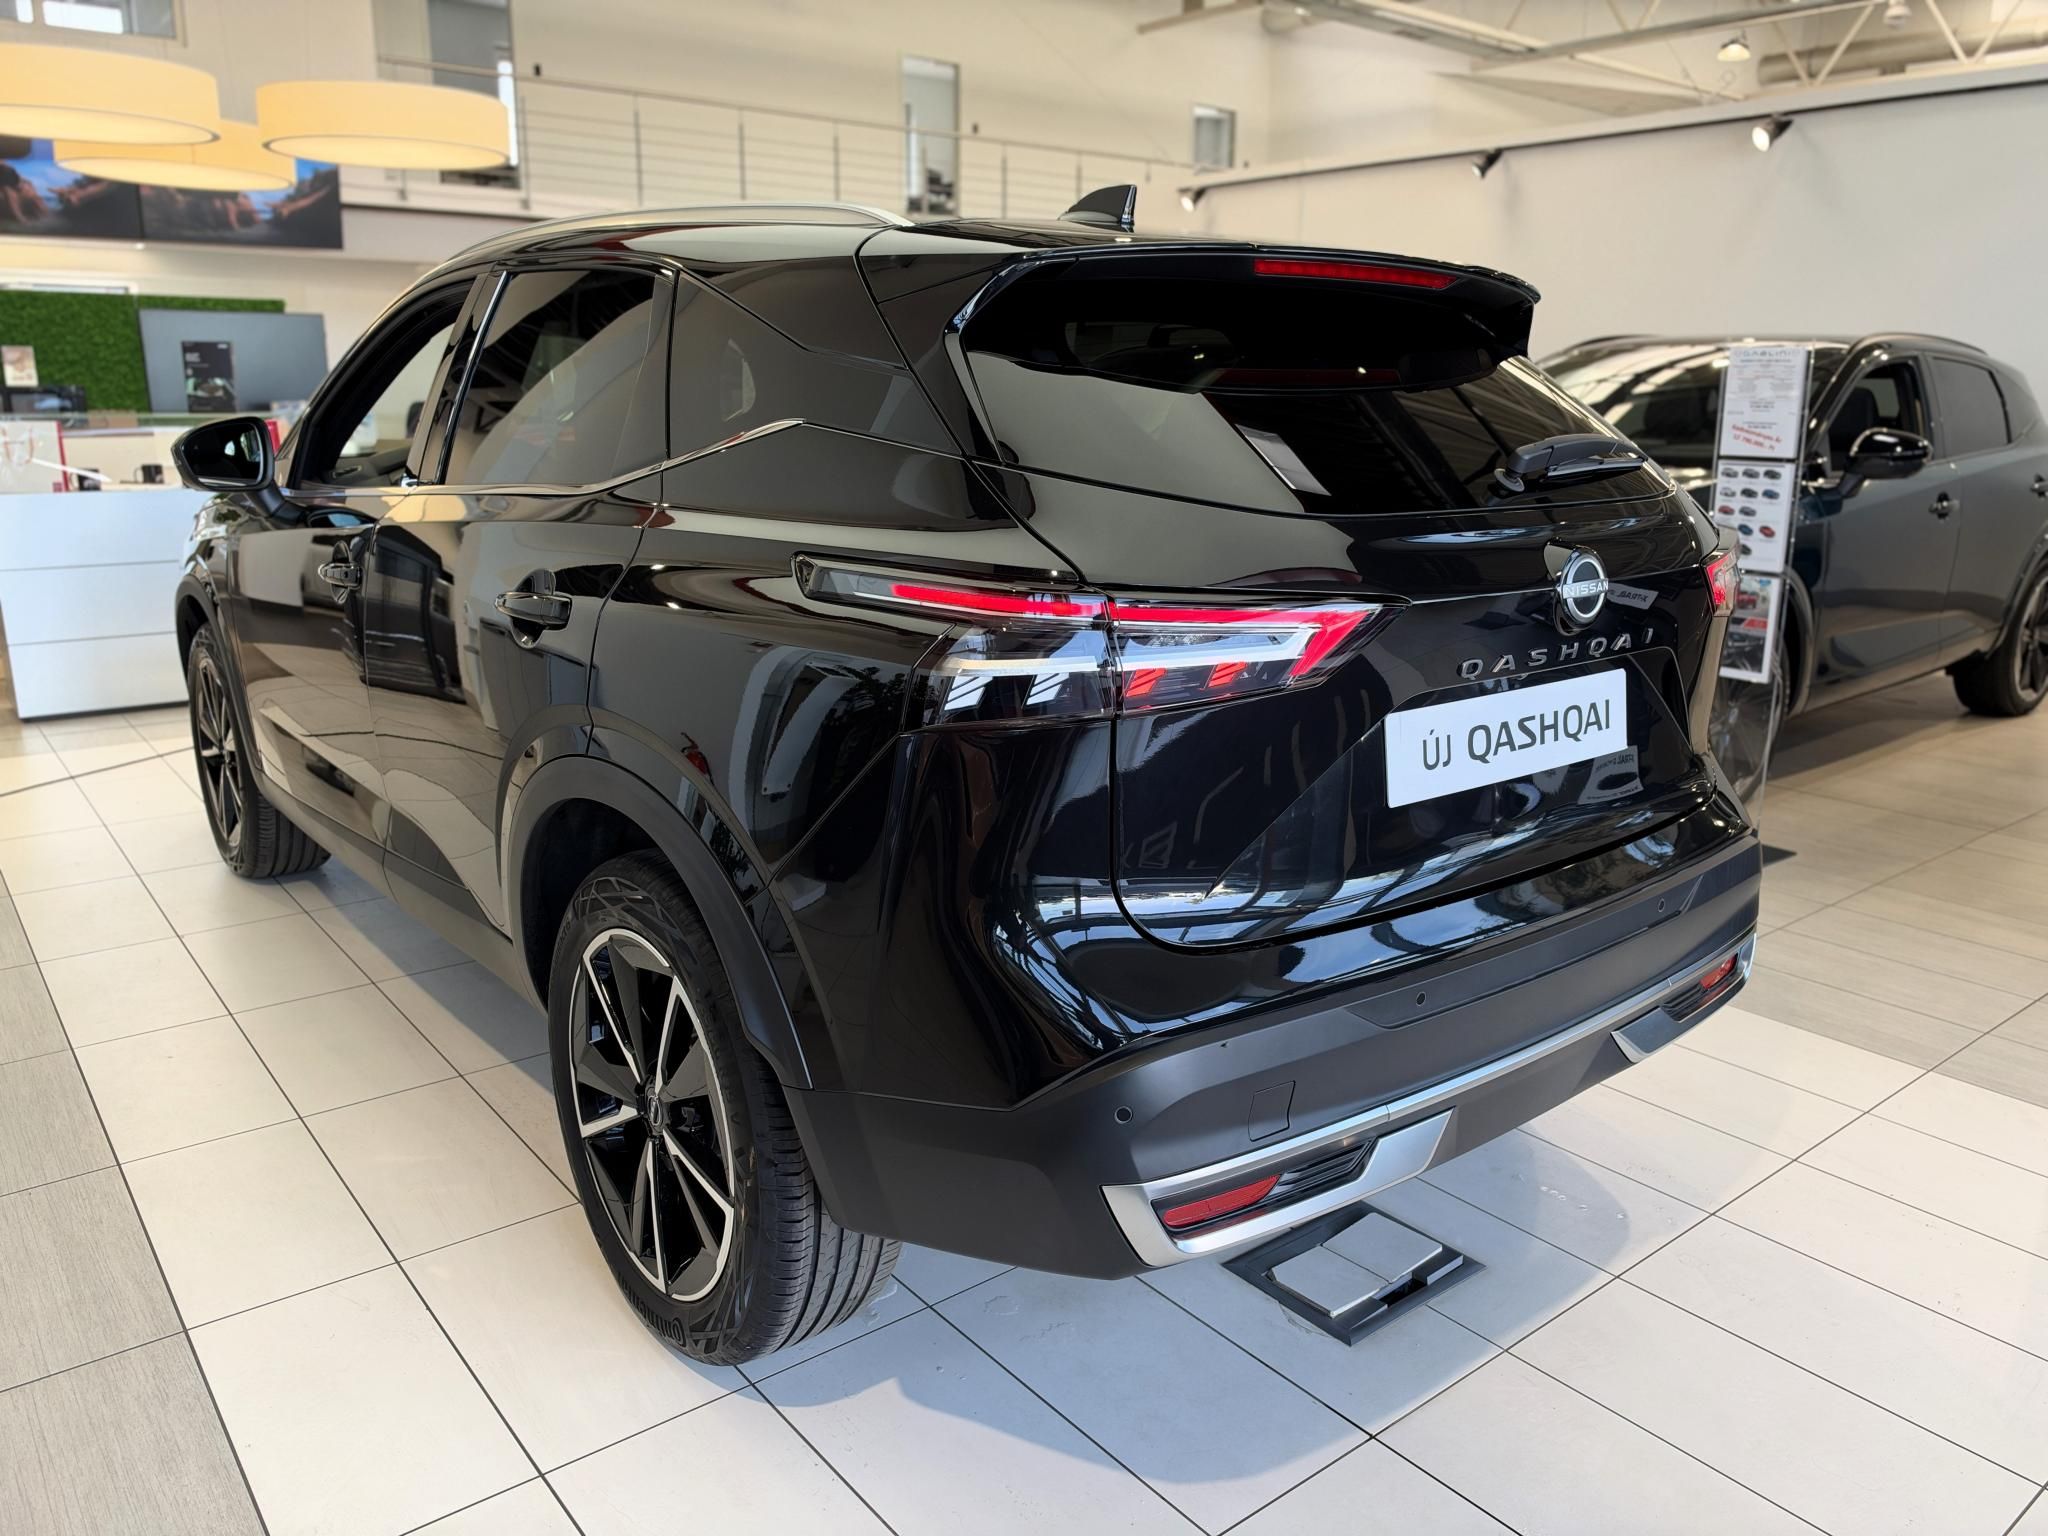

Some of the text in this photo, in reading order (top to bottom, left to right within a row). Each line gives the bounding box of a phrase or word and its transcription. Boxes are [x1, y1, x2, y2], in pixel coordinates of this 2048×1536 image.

[1565, 578, 1609, 596] NISSAN
[1458, 627, 1655, 680] QASHQAI
[1422, 699, 1611, 771] ÚJ QASHQAI
